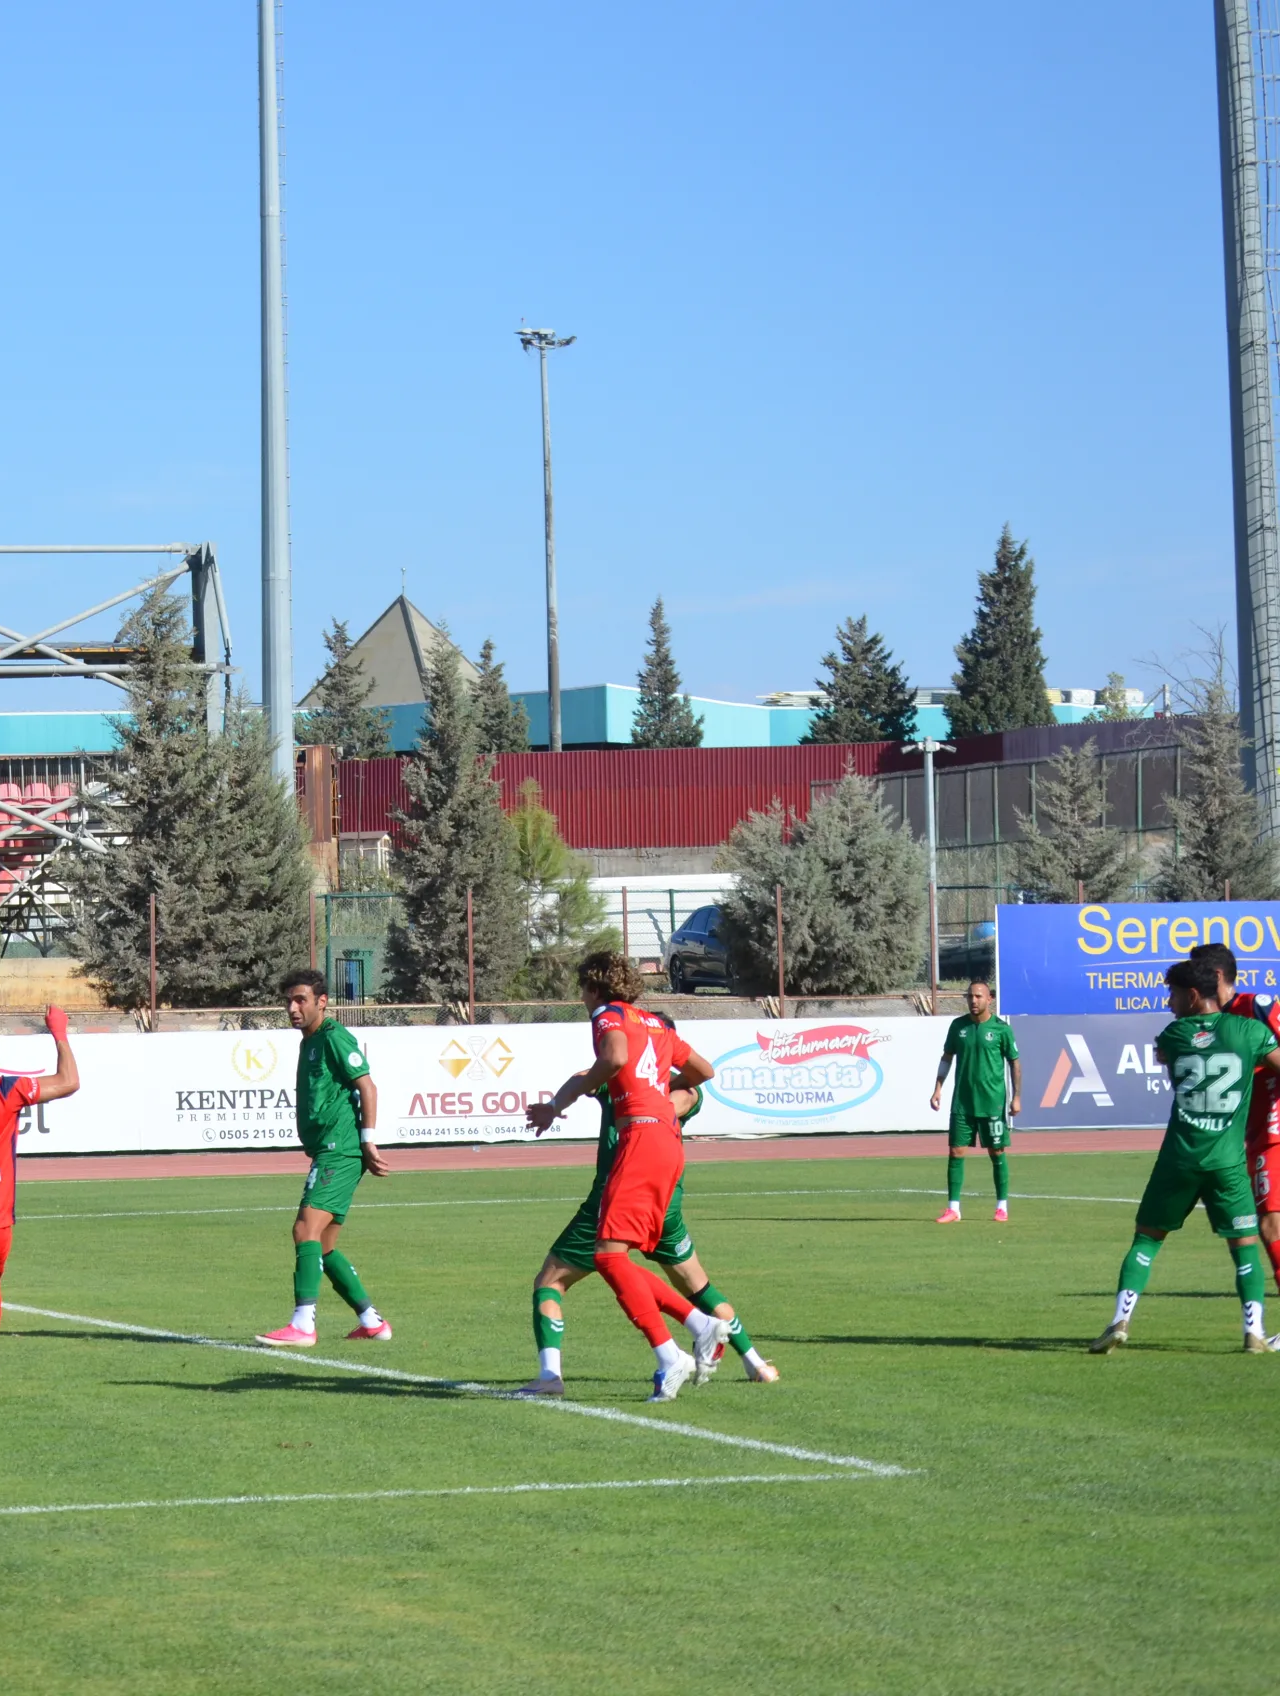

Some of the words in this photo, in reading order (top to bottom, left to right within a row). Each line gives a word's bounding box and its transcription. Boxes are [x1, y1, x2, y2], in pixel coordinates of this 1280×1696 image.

[1077, 904, 1280, 955] Serenov
[1086, 970, 1170, 989] THERMA
[1264, 969, 1276, 987] &
[245, 1049, 263, 1070] K
[635, 1035, 658, 1087] 4
[1116, 1043, 1163, 1074] AL
[720, 1062, 863, 1091] marasta
[1173, 1052, 1242, 1114] 22
[175, 1088, 297, 1111] KENTPA
[755, 1091, 835, 1104] DONDURMA
[176, 1111, 266, 1122] PREMIUM
[219, 1130, 250, 1140] 0505
[253, 1129, 275, 1139] 215
[279, 1128, 293, 1138] 02
[409, 1128, 433, 1136] 0344
[434, 1127, 451, 1135] 241
[454, 1127, 466, 1135] 55
[467, 1126, 479, 1135] 66
[494, 1126, 517, 1134] 0544
[988, 1120, 1004, 1137] 10
